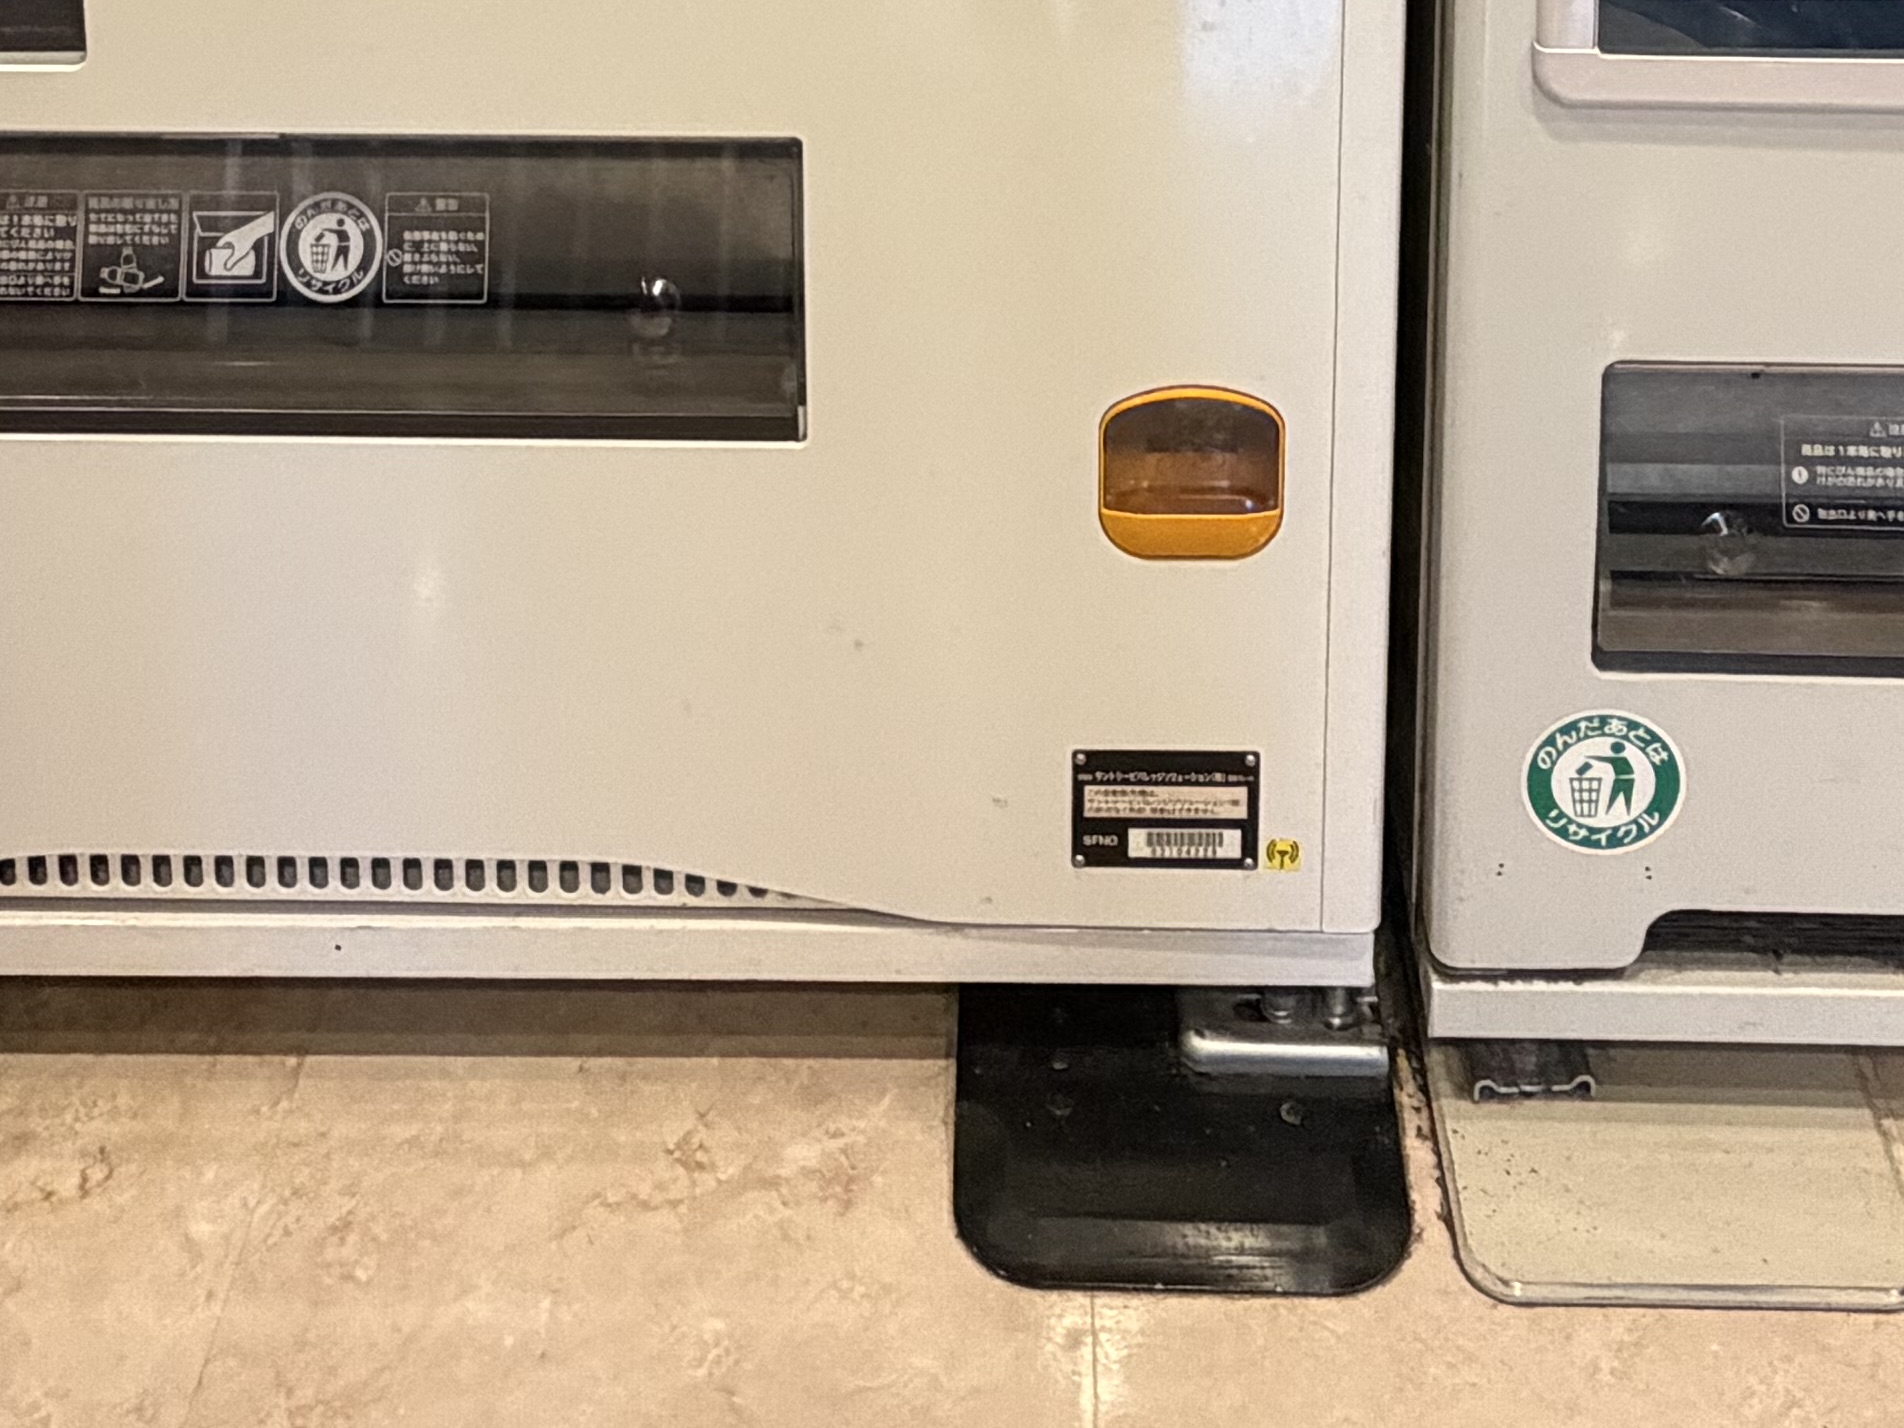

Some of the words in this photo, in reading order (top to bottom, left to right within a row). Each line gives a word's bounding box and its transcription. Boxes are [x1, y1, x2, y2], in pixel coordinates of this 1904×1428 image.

[1537, 715, 1670, 773] のんだあとは
[1544, 806, 1662, 848] リサイクル
